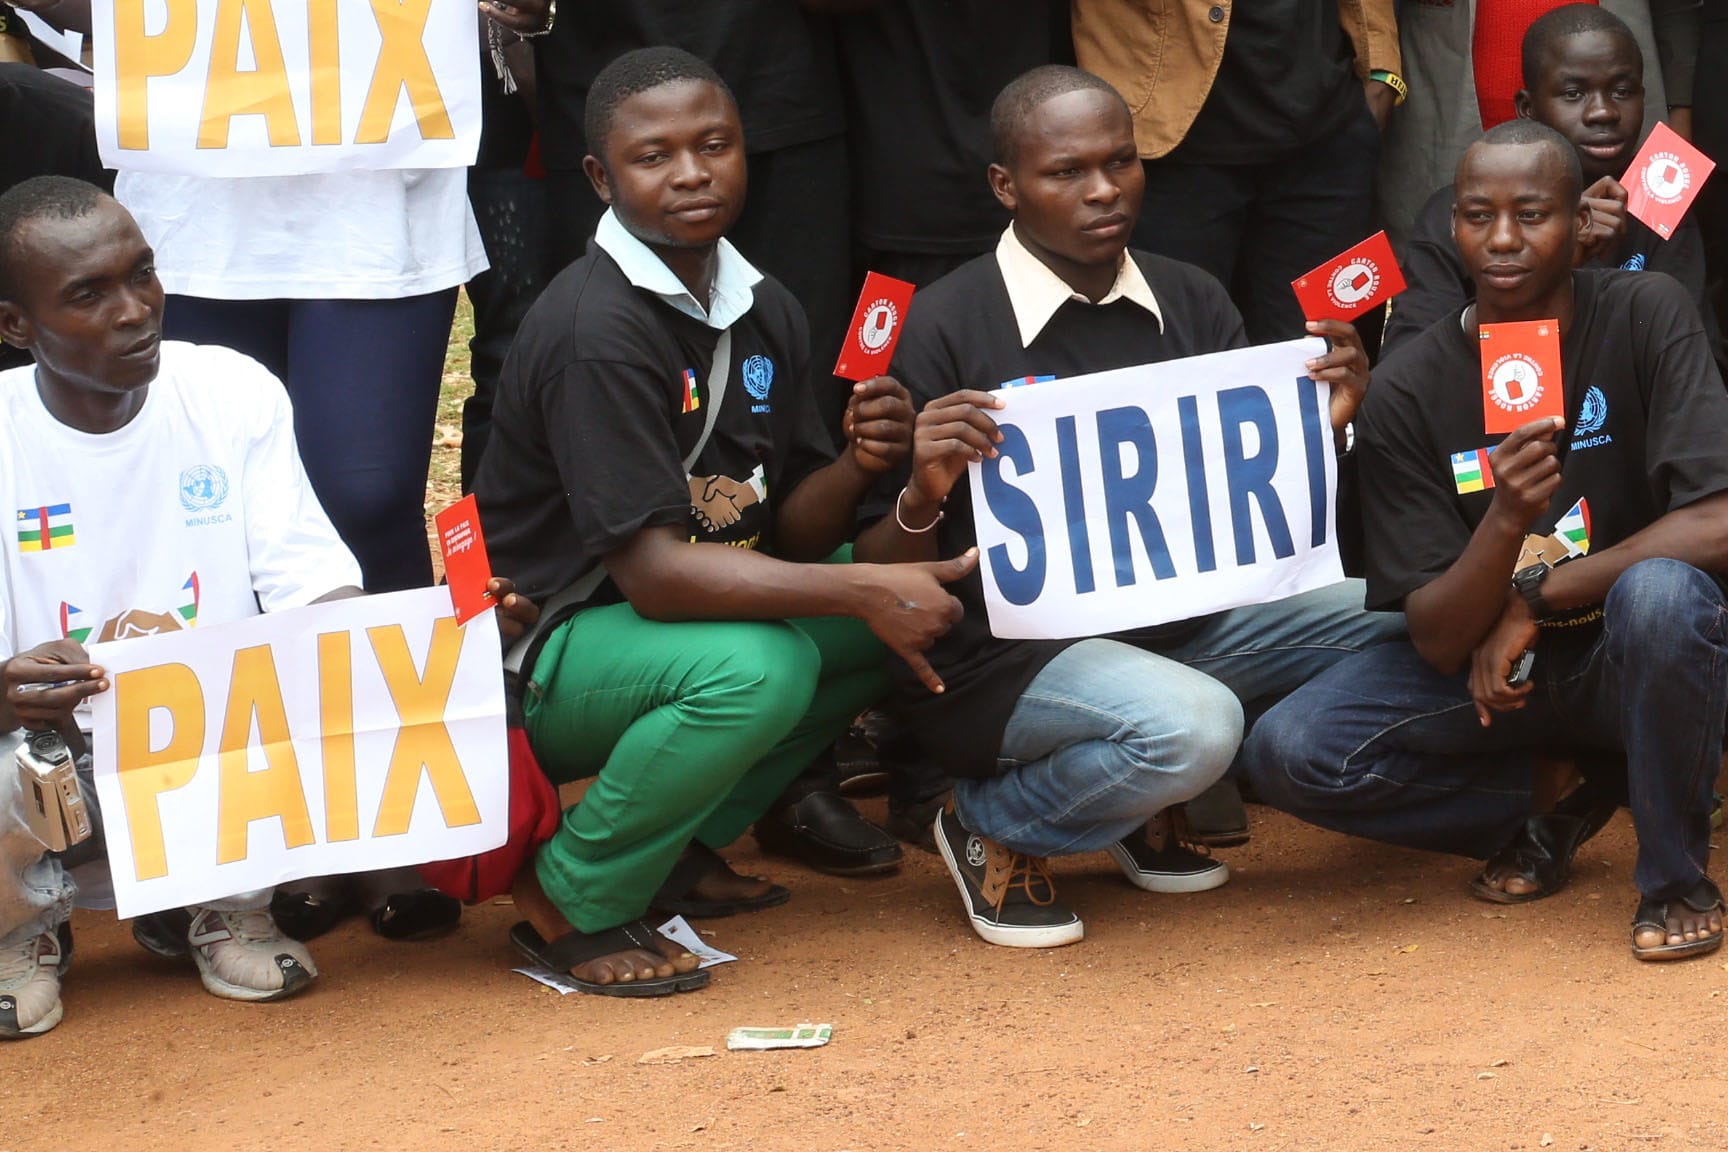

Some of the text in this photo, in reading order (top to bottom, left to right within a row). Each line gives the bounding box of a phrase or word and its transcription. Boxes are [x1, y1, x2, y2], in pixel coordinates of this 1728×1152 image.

[1350, 257, 1378, 272] CARTON
[1516, 385, 1544, 411] CARTON
[1570, 435, 1613, 451] MINUSCA
[980, 374, 1328, 607] SIRIRI
[185, 513, 233, 528] MINUSCA
[114, 616, 482, 882] PAIX
